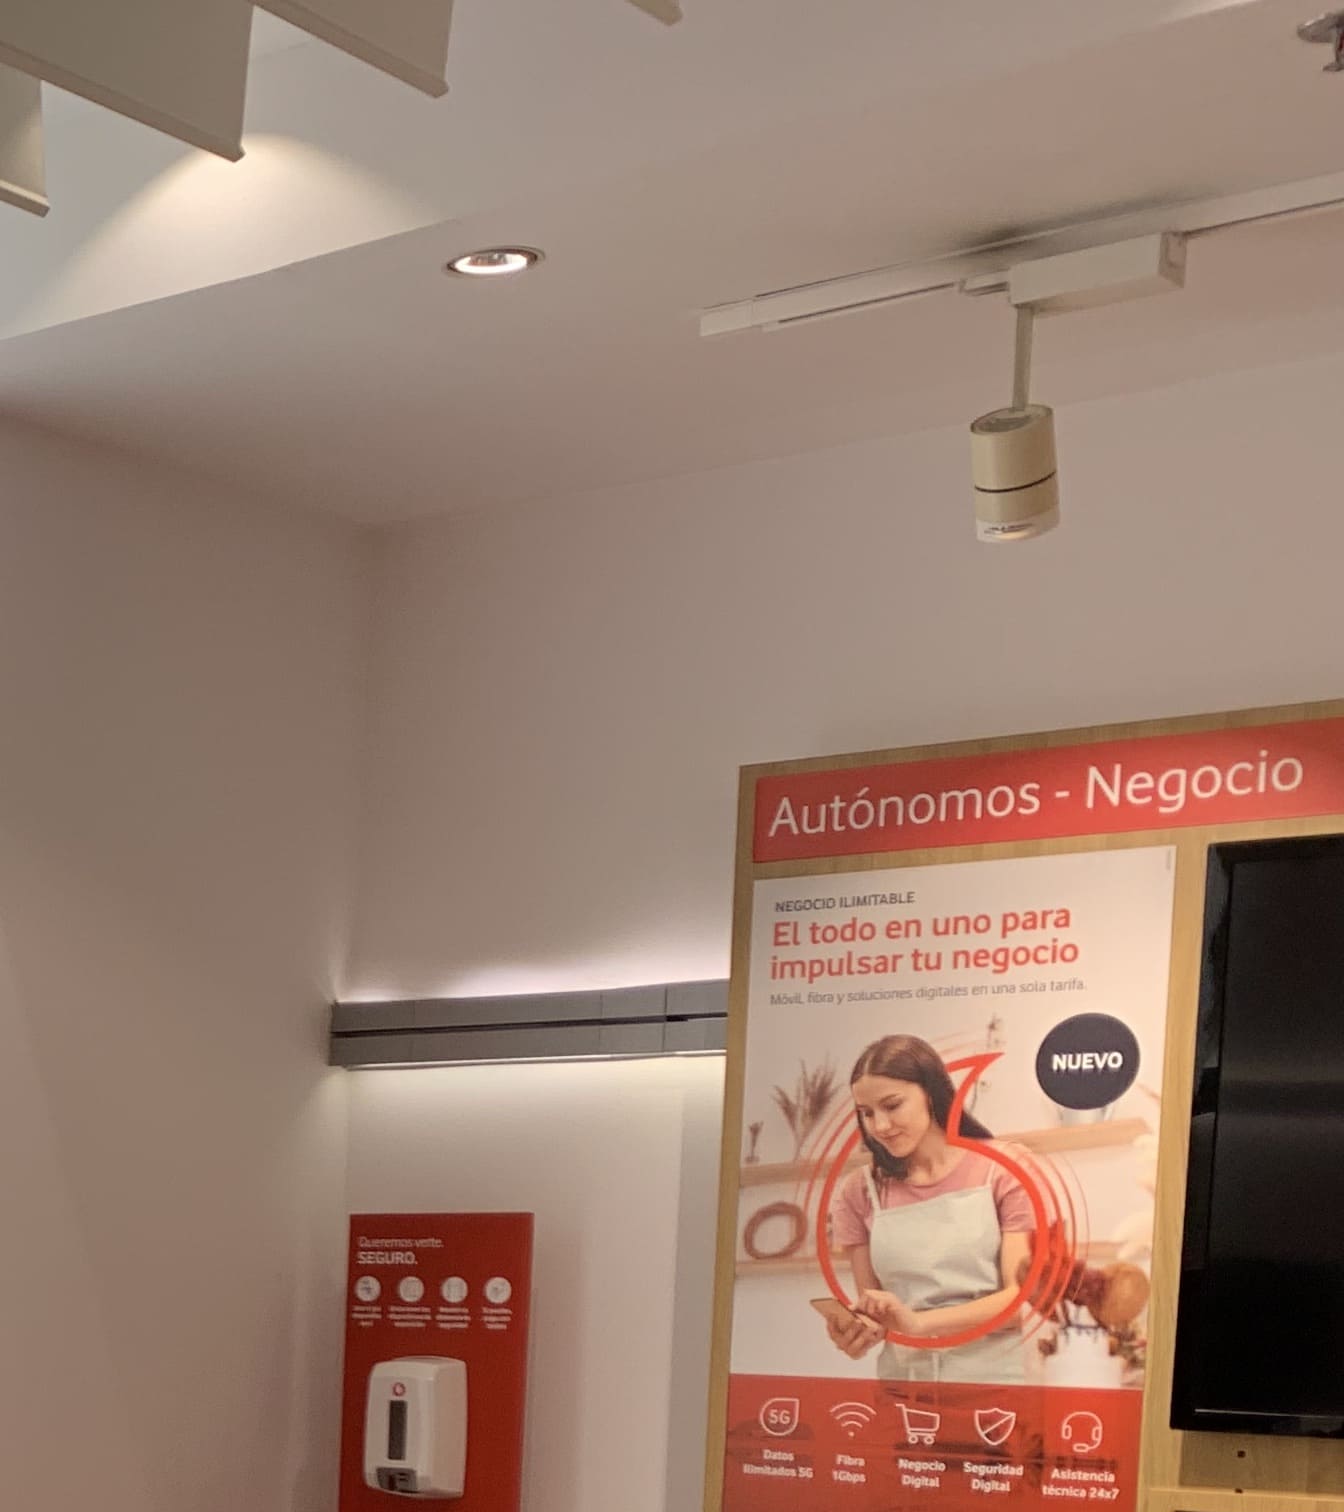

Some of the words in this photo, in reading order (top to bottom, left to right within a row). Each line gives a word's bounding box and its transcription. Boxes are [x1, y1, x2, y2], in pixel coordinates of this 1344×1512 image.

[767, 782, 1042, 837] Autónomos
[1085, 750, 1304, 814] Negocio
[774, 896, 837, 913] NEGOCIO
[838, 891, 916, 909] ILIMITABLE
[773, 920, 800, 947] El
[809, 917, 876, 945] todo
[885, 917, 923, 941] en
[932, 913, 992, 938] uno
[1001, 907, 1072, 939] para
[769, 949, 905, 984] impulsar
[911, 947, 942, 973] tu
[952, 937, 1080, 975] negocio
[807, 988, 835, 1004] fibra
[836, 991, 846, 1005] y
[847, 986, 914, 1003] soluciones
[915, 984, 969, 1001] digitales
[971, 985, 989, 997] en
[991, 982, 1017, 995] una
[1018, 979, 1047, 994] sola
[1049, 976, 1088, 992] tarifa.
[1052, 1051, 1124, 1072] NUEVO
[767, 1408, 791, 1425] 5G
[762, 1449, 795, 1462] Datos
[835, 1454, 866, 1467] Fibra
[743, 1464, 797, 1478] Ilimitados
[798, 1467, 814, 1479] 5G
[898, 1458, 947, 1473] Negocio
[963, 1461, 1024, 1477] Seguridad
[832, 1470, 866, 1484] 1Gbps
[901, 1474, 941, 1489] Digital
[1051, 1468, 1116, 1483] Asistencia
[971, 1478, 1011, 1494] Digital
[1041, 1484, 1087, 1499] técnica
[1088, 1487, 1120, 1501] 24x7
